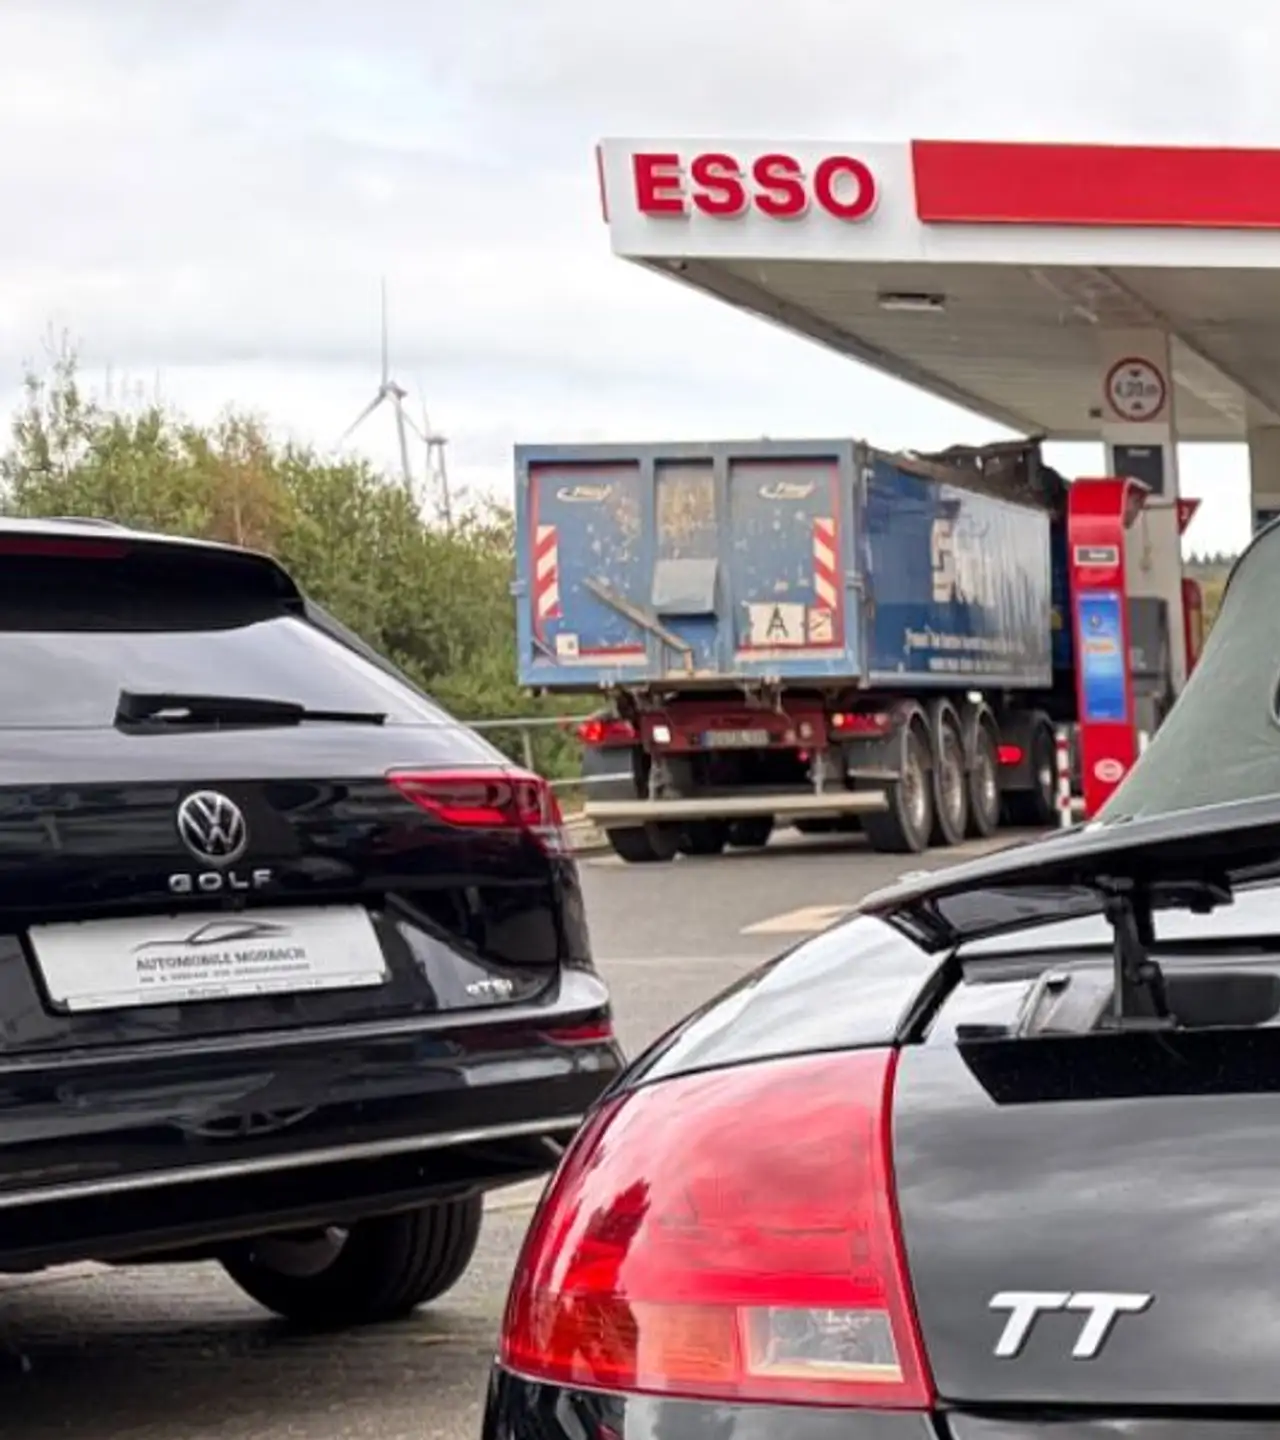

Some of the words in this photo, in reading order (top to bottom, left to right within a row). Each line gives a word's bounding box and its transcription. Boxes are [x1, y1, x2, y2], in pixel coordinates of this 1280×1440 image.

[632, 153, 877, 220] ESSO
[766, 606, 789, 638] A
[168, 869, 273, 892] GOLF
[988, 1291, 1155, 1359] TT
